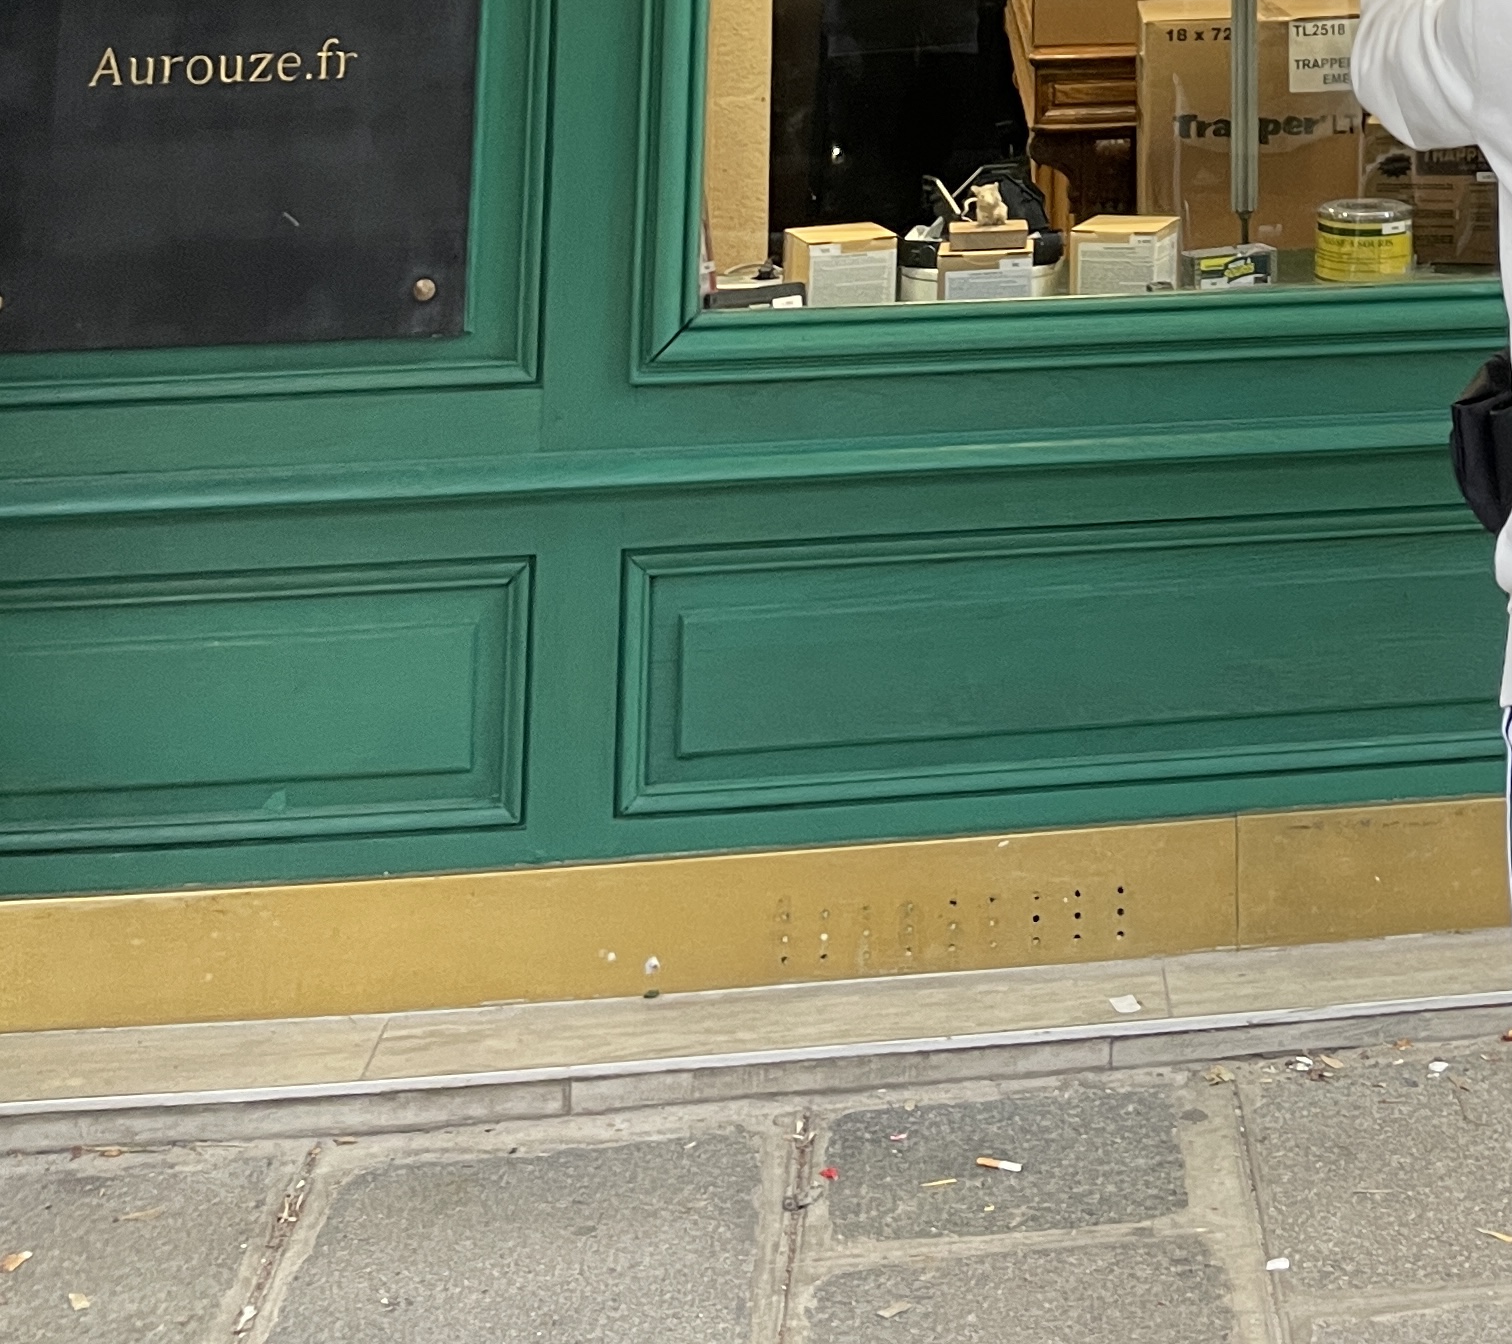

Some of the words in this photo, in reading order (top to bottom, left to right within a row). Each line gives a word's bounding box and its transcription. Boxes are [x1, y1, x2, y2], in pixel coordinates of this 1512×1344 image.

[1166, 27, 1188, 42] 18
[1194, 31, 1205, 42] x
[1293, 23, 1346, 38] TL2518
[89, 37, 359, 87] Aurouze.fr
[1173, 113, 1321, 146] Traper
